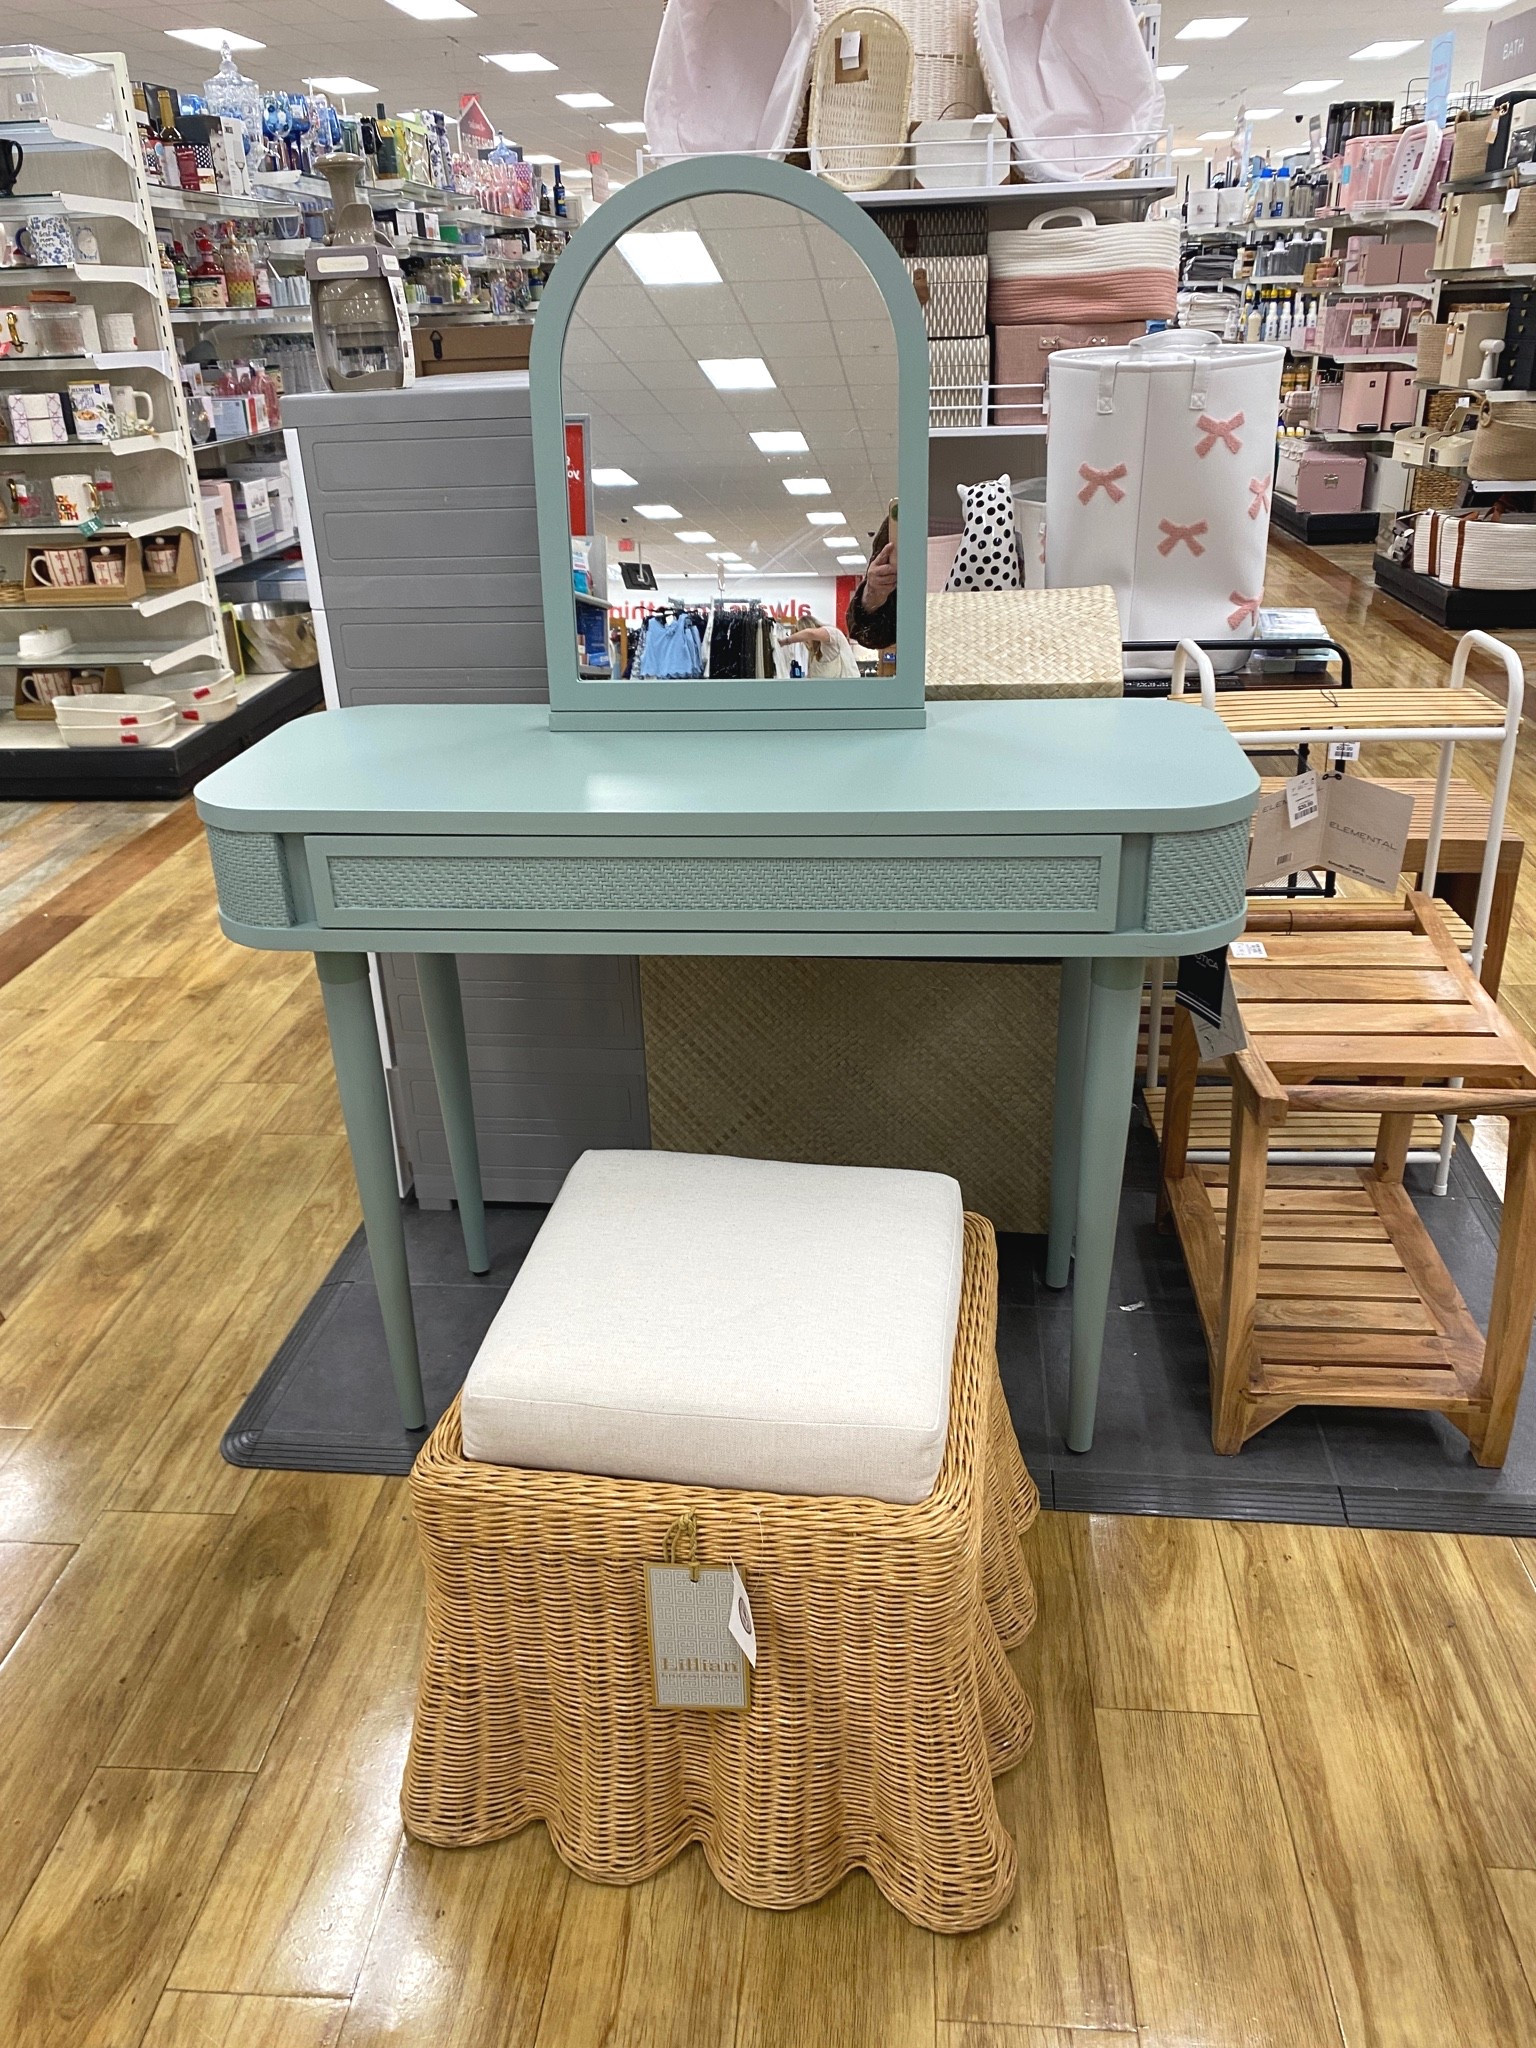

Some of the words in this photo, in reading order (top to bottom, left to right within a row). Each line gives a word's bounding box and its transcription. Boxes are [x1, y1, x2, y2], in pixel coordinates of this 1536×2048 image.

[1502, 38, 1525, 60] BATH
[1329, 821, 1398, 851] ELEMENTAL
[662, 1656, 739, 1672] Lillian
